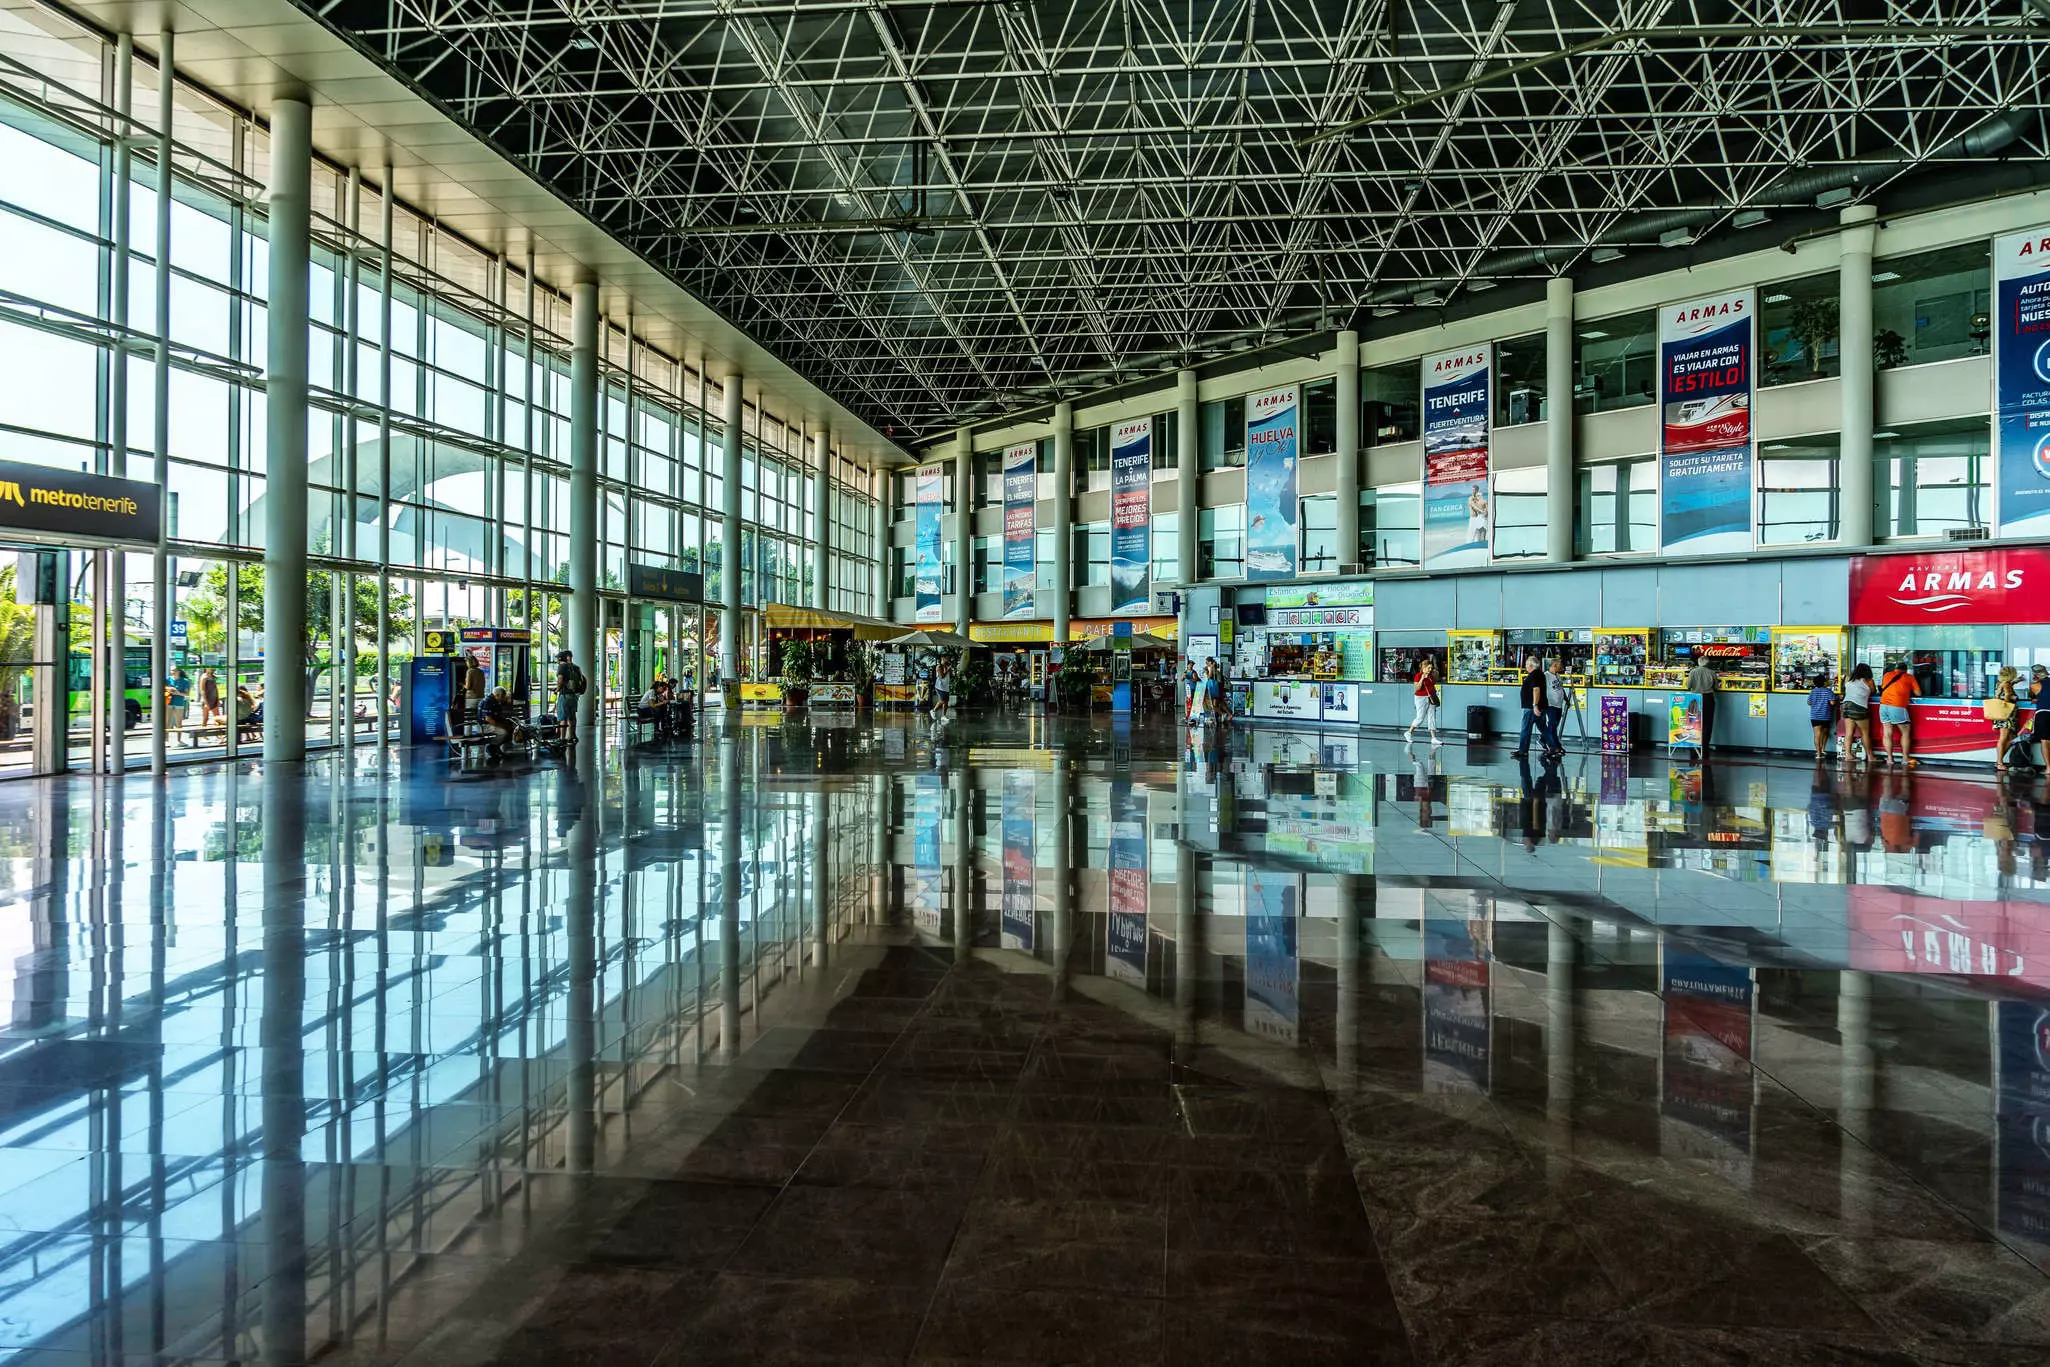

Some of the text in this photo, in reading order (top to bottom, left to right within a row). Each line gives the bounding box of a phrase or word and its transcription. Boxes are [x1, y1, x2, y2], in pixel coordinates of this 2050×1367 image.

[2021, 297, 2041, 305] Ahora
[2021, 302, 2045, 311] tarjeta
[1677, 299, 1744, 323] ARMAS
[1674, 344, 1739, 362] VIAJAR EN ARMAS
[1435, 352, 1484, 372] ARMAS
[1674, 355, 1739, 373] ES VIAJAR CON
[1675, 367, 1739, 392] ESTILO
[1256, 392, 1293, 407] ARMAS
[1429, 389, 1485, 409] TENERIFE
[1430, 414, 1485, 429] FUERTEVENTURA
[1118, 423, 1148, 436] ARMAS
[1251, 427, 1294, 444] HUELVA
[1719, 421, 1745, 437] Style
[1009, 447, 1033, 458] ARMAS
[1114, 454, 1149, 468] TENERIFE
[1669, 453, 1743, 467] SOLICITE SU TARJETA
[921, 466, 941, 476] ARMAS
[1669, 462, 1744, 477] GRATUITAMENTE
[1006, 474, 1034, 486] TENERIFE
[1115, 476, 1123, 485] LA
[1125, 472, 1147, 483] PALMA
[30, 488, 137, 515] metrotenerife
[1115, 504, 1147, 515] MEJORES
[1007, 519, 1032, 529] TARIFAS
[1117, 515, 1144, 525] PRECIOS
[1898, 570, 2024, 592] ARMAS
[172, 624, 186, 634] 39
[974, 626, 1041, 638] RESTAURANTE
[1085, 623, 1150, 636] CAFERIA
[1704, 646, 1744, 657] Coca-Cola
